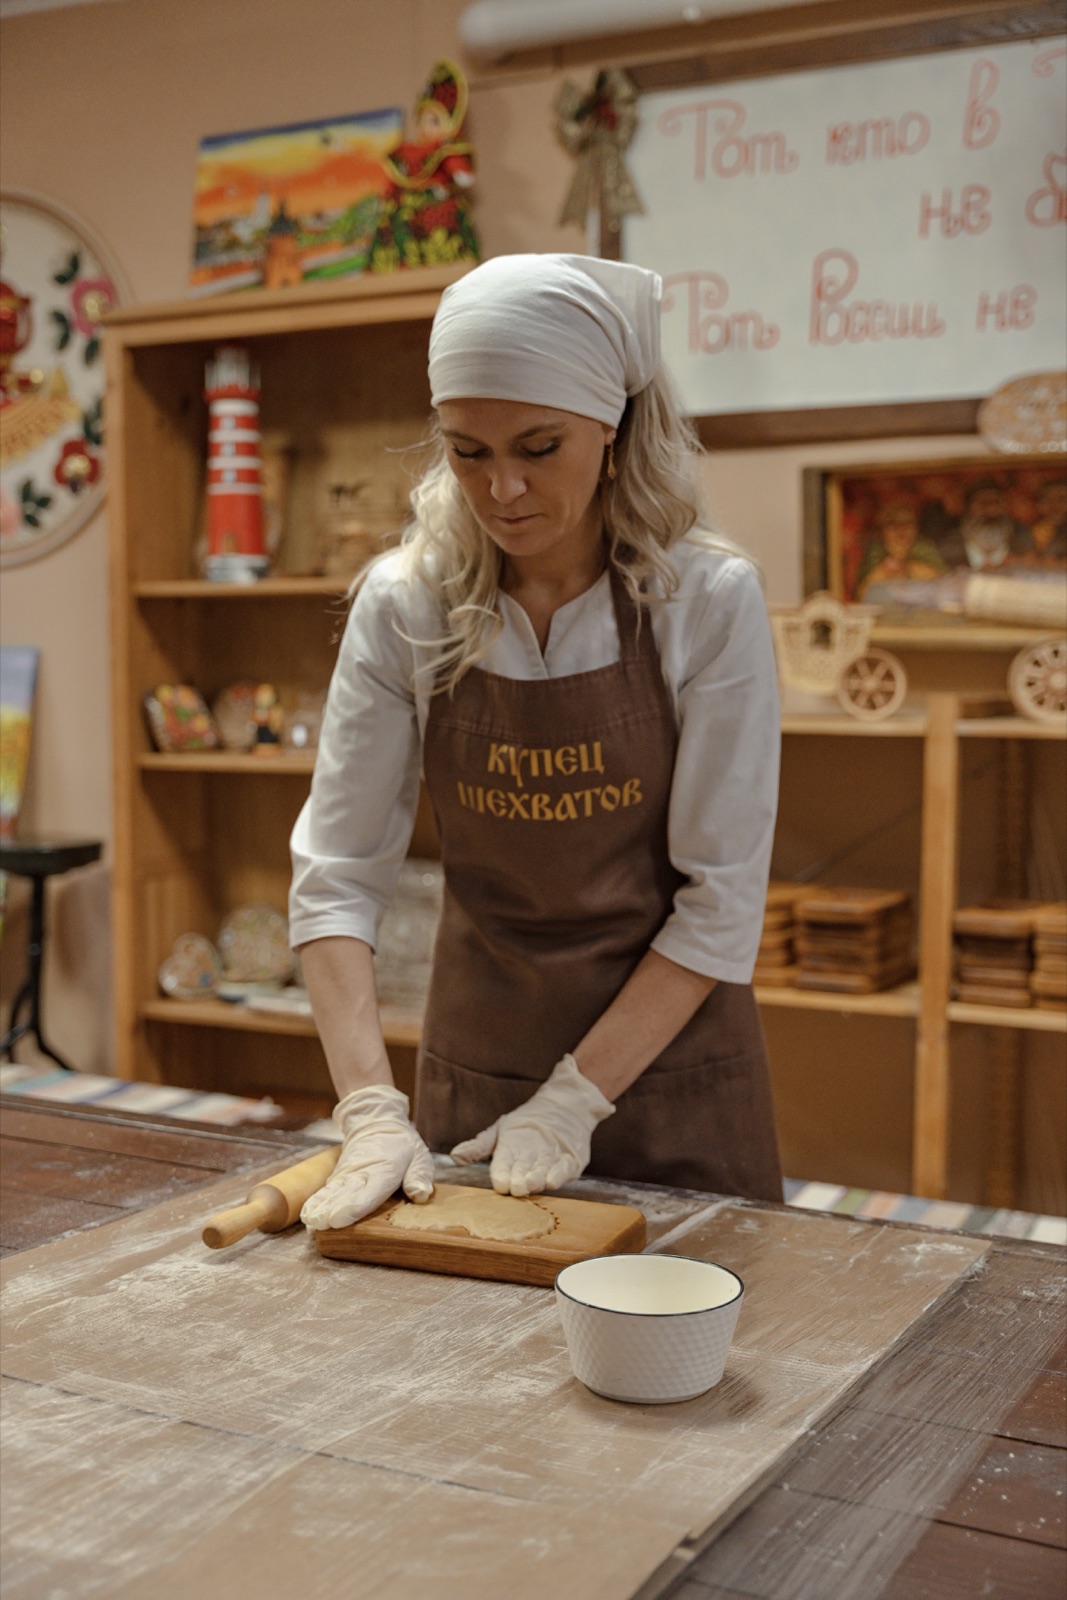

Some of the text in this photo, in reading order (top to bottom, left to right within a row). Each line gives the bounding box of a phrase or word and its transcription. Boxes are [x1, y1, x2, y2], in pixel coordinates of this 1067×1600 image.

[656, 99, 799, 183] Тот
[825, 111, 931, 166] кто
[918, 183, 992, 239] не
[975, 283, 1038, 332] не
[487, 741, 605, 788] КУПЕЦ
[457, 777, 643, 822] ШЕХВАТОВ
